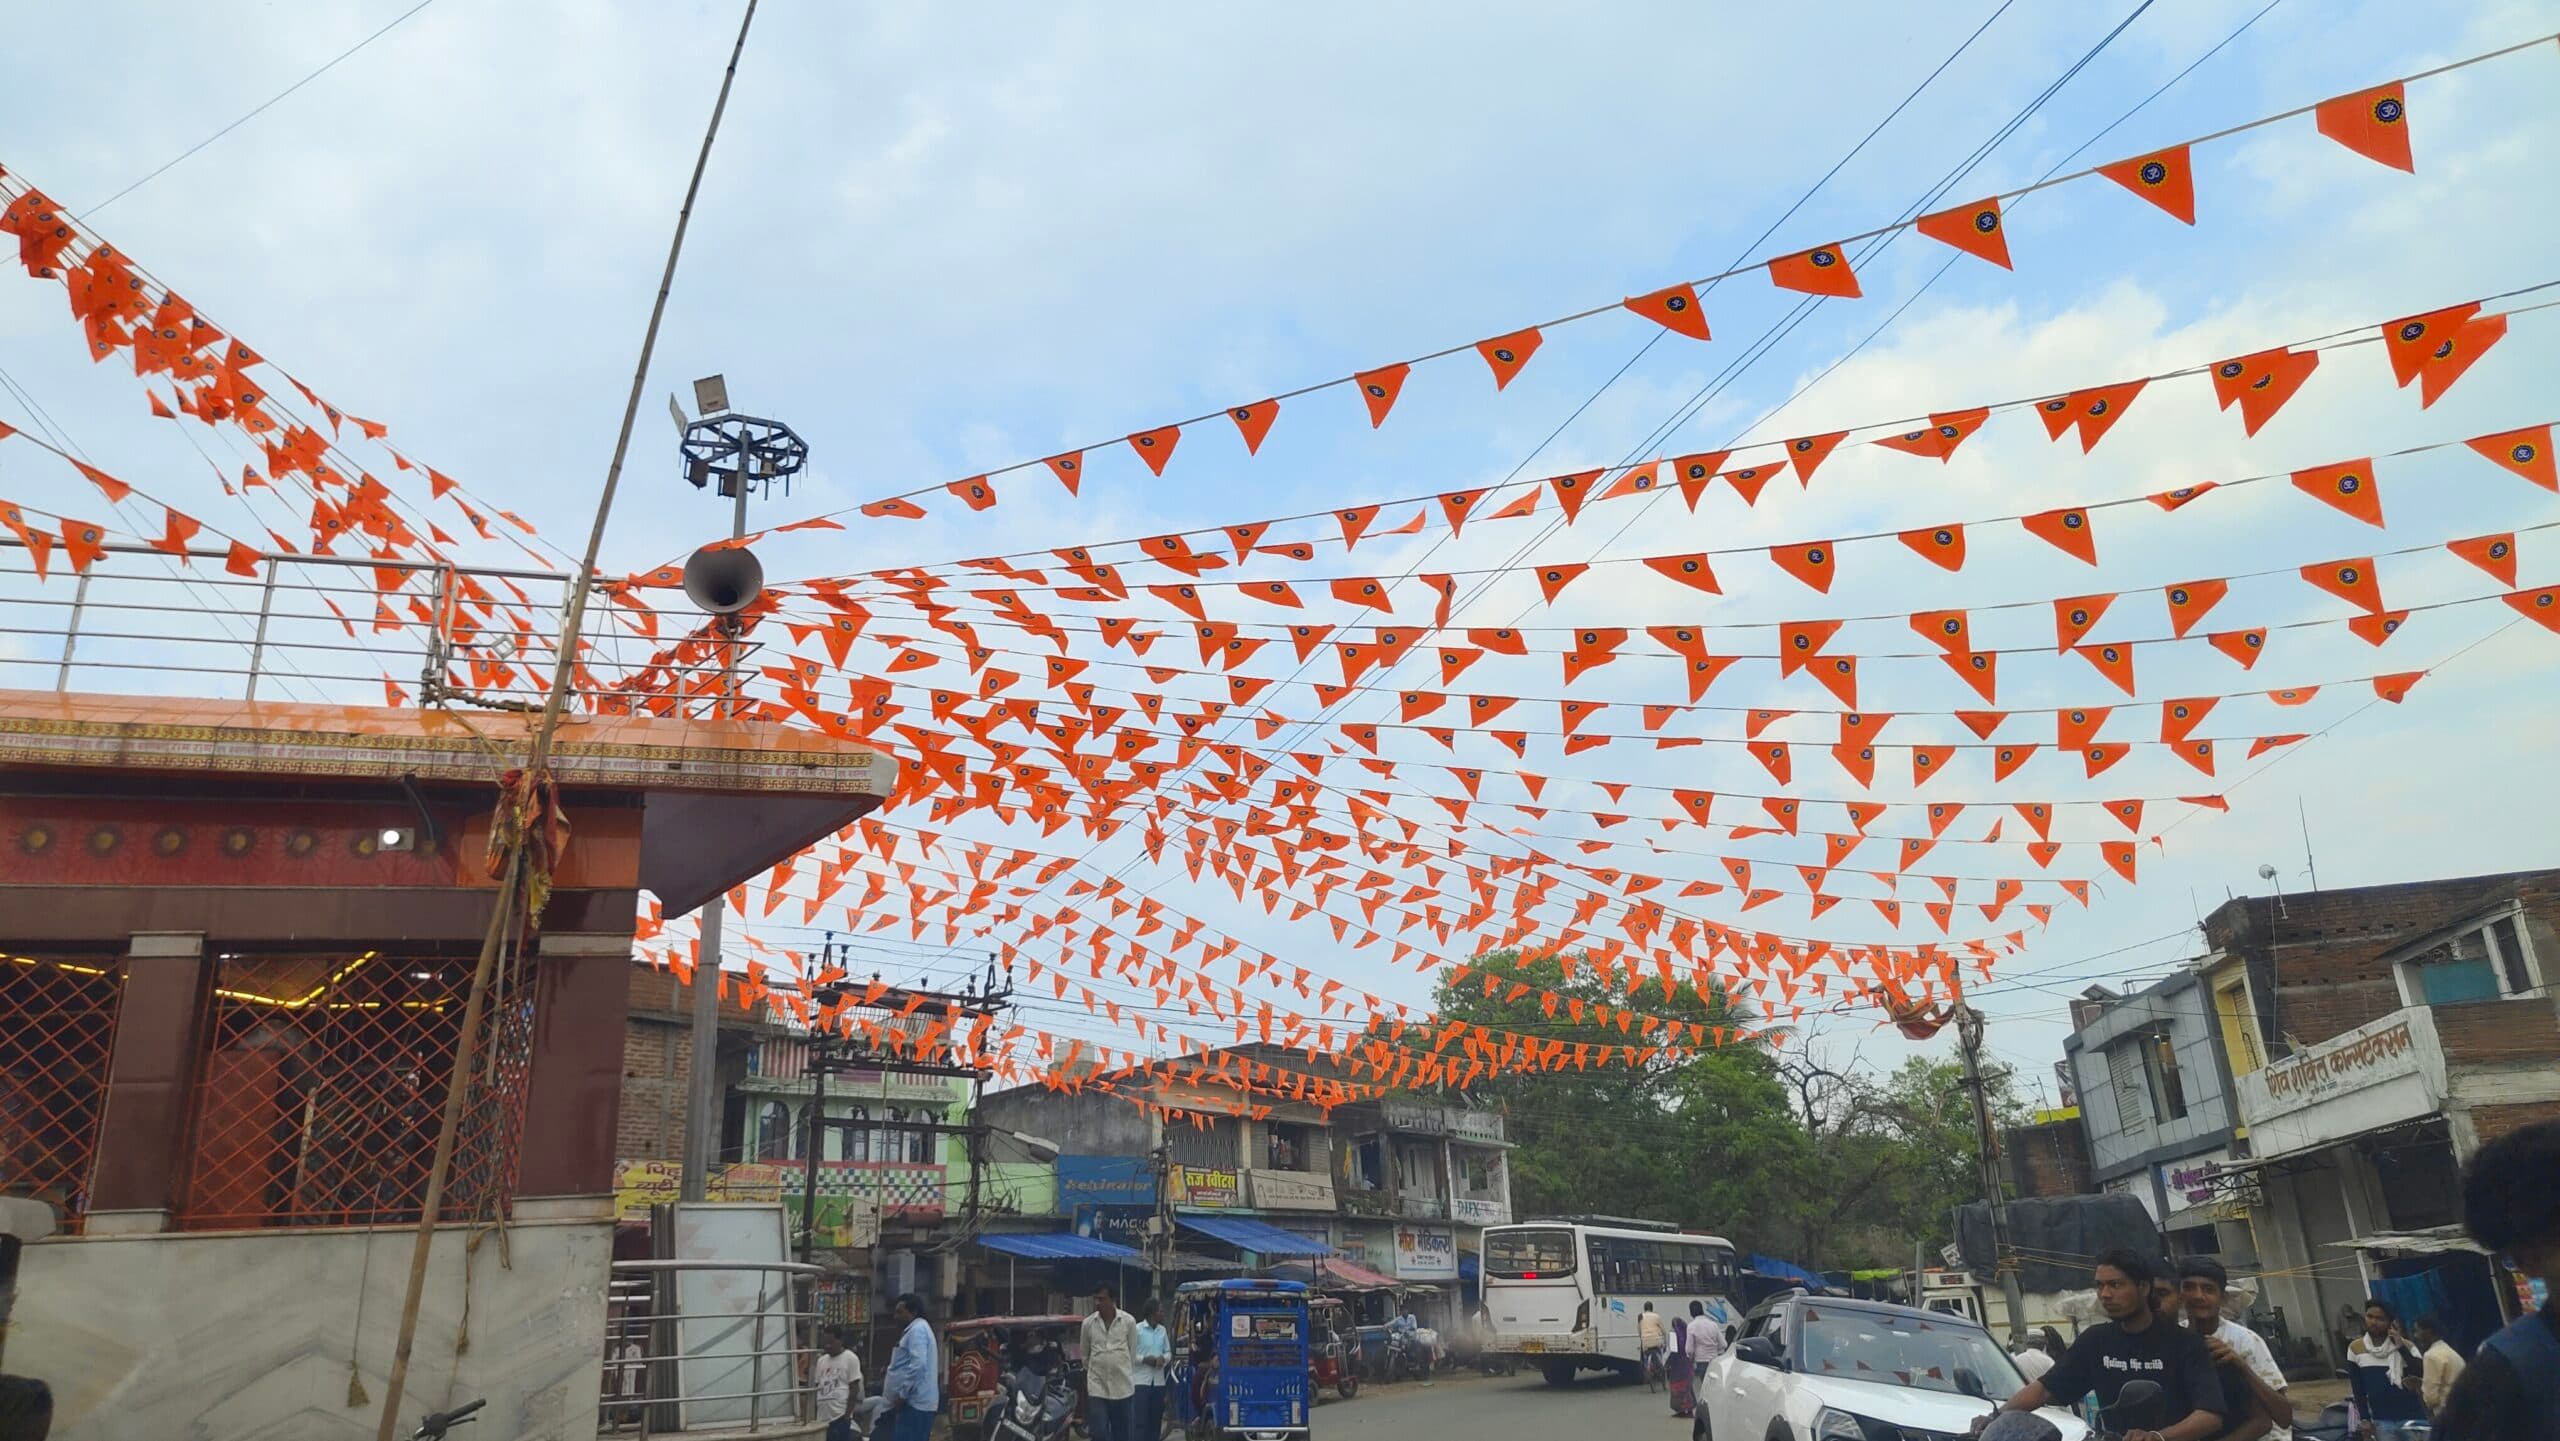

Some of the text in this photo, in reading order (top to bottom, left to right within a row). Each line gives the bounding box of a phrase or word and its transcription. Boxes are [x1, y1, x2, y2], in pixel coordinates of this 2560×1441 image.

[2265, 1066, 2292, 1100] शिव
[2291, 1049, 2330, 1096] शक्ति
[1185, 1172, 1205, 1187] राज
[2129, 1358, 2142, 1372] the
